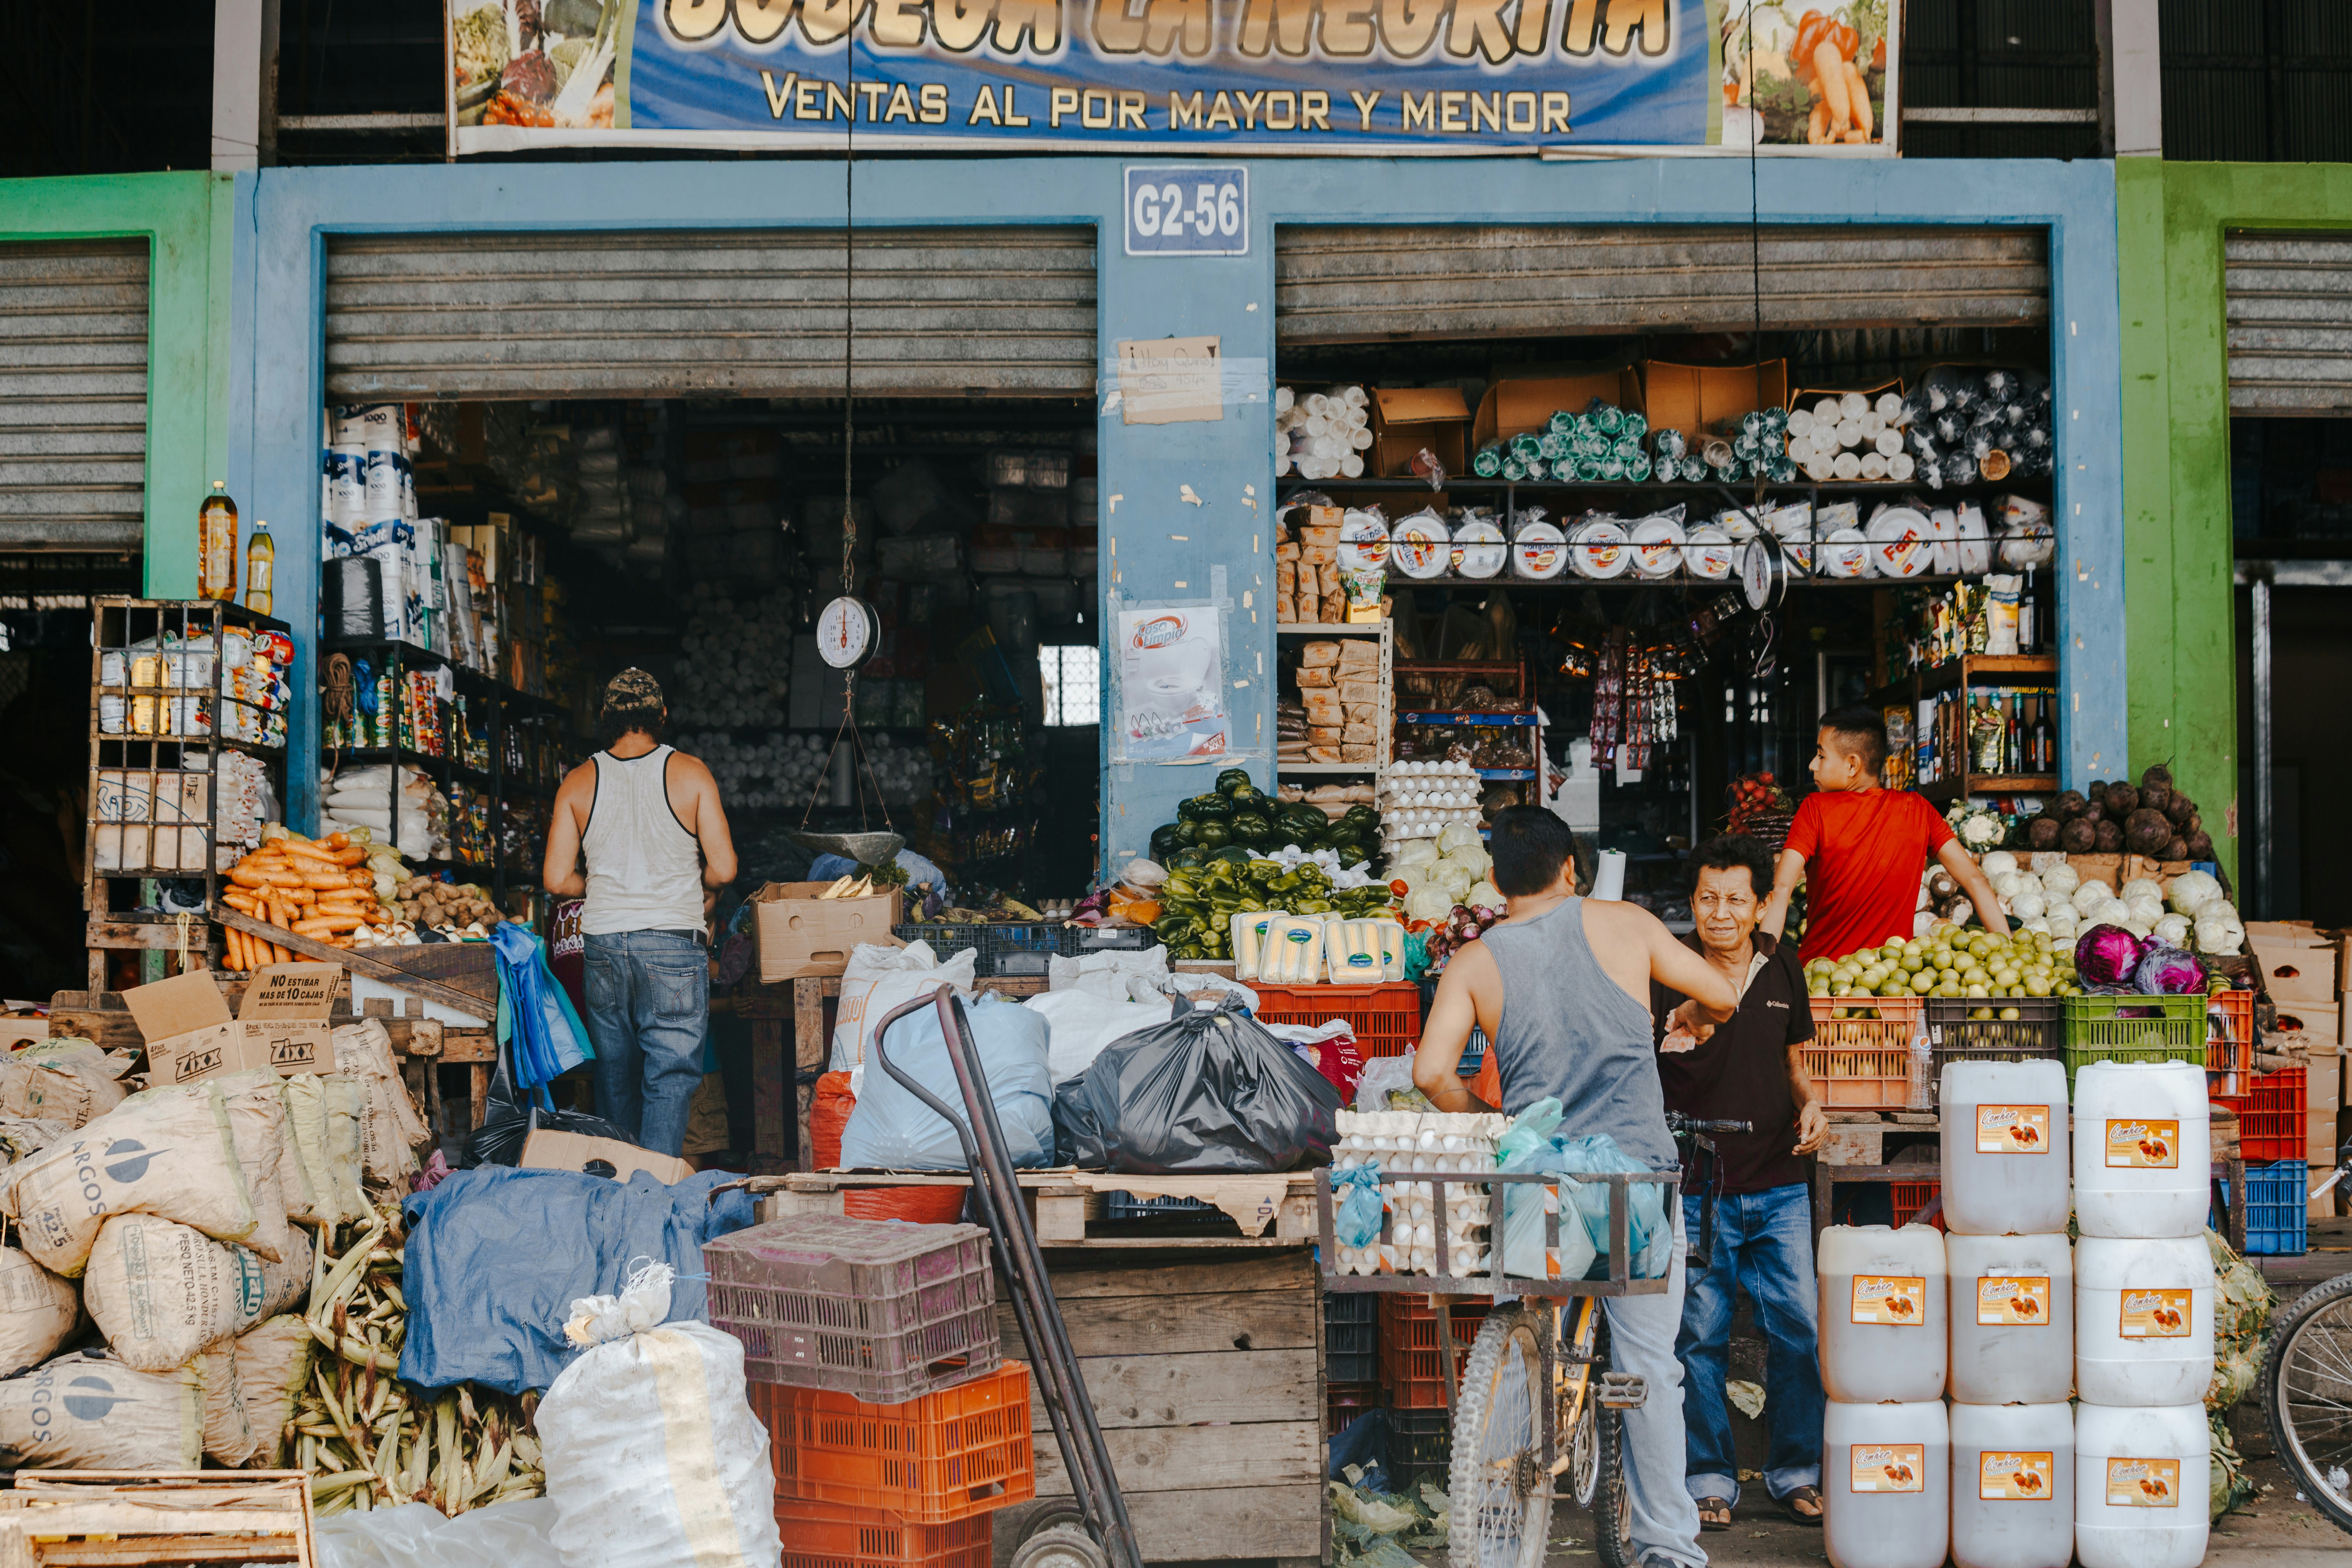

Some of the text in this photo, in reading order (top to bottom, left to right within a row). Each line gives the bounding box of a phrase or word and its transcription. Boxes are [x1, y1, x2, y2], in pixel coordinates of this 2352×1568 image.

[759, 70, 1571, 133] VENTAS AL POR MAYOR Y MENOR
[1133, 184, 1239, 238] G2-56
[353, 527, 388, 552] Scott
[1138, 622, 1167, 637] Casa
[1143, 628, 1183, 647] Limpia
[270, 974, 286, 987] NO
[287, 988, 299, 999] 10
[301, 991, 324, 999] CAJAS
[271, 1039, 314, 1064] Zixx
[176, 1047, 222, 1080] Zixx
[1982, 1108, 2017, 1124] Comher
[2111, 1122, 2146, 1139] Comher
[369, 1131, 377, 1152] PESO
[70, 1140, 107, 1216] ARGOS
[42, 1210, 68, 1248] 42.5
[179, 1233, 192, 1259] PESO
[134, 1258, 143, 1273] NO
[197, 1252, 207, 1281] SULA,
[206, 1247, 217, 1283] A.S.T.M.
[136, 1284, 145, 1296] las
[1858, 1278, 1892, 1295] Comher
[1982, 1280, 2017, 1297] Comher
[186, 1292, 196, 1311] 42.5
[209, 1286, 220, 1318] C-1157
[2127, 1292, 2161, 1309] Comher
[185, 1314, 197, 1325] kg
[199, 1283, 209, 1340] HONDURAS,
[1857, 1447, 1891, 1464] Comher
[1986, 1455, 2021, 1471] Comher
[2112, 1461, 2146, 1478] Comher
